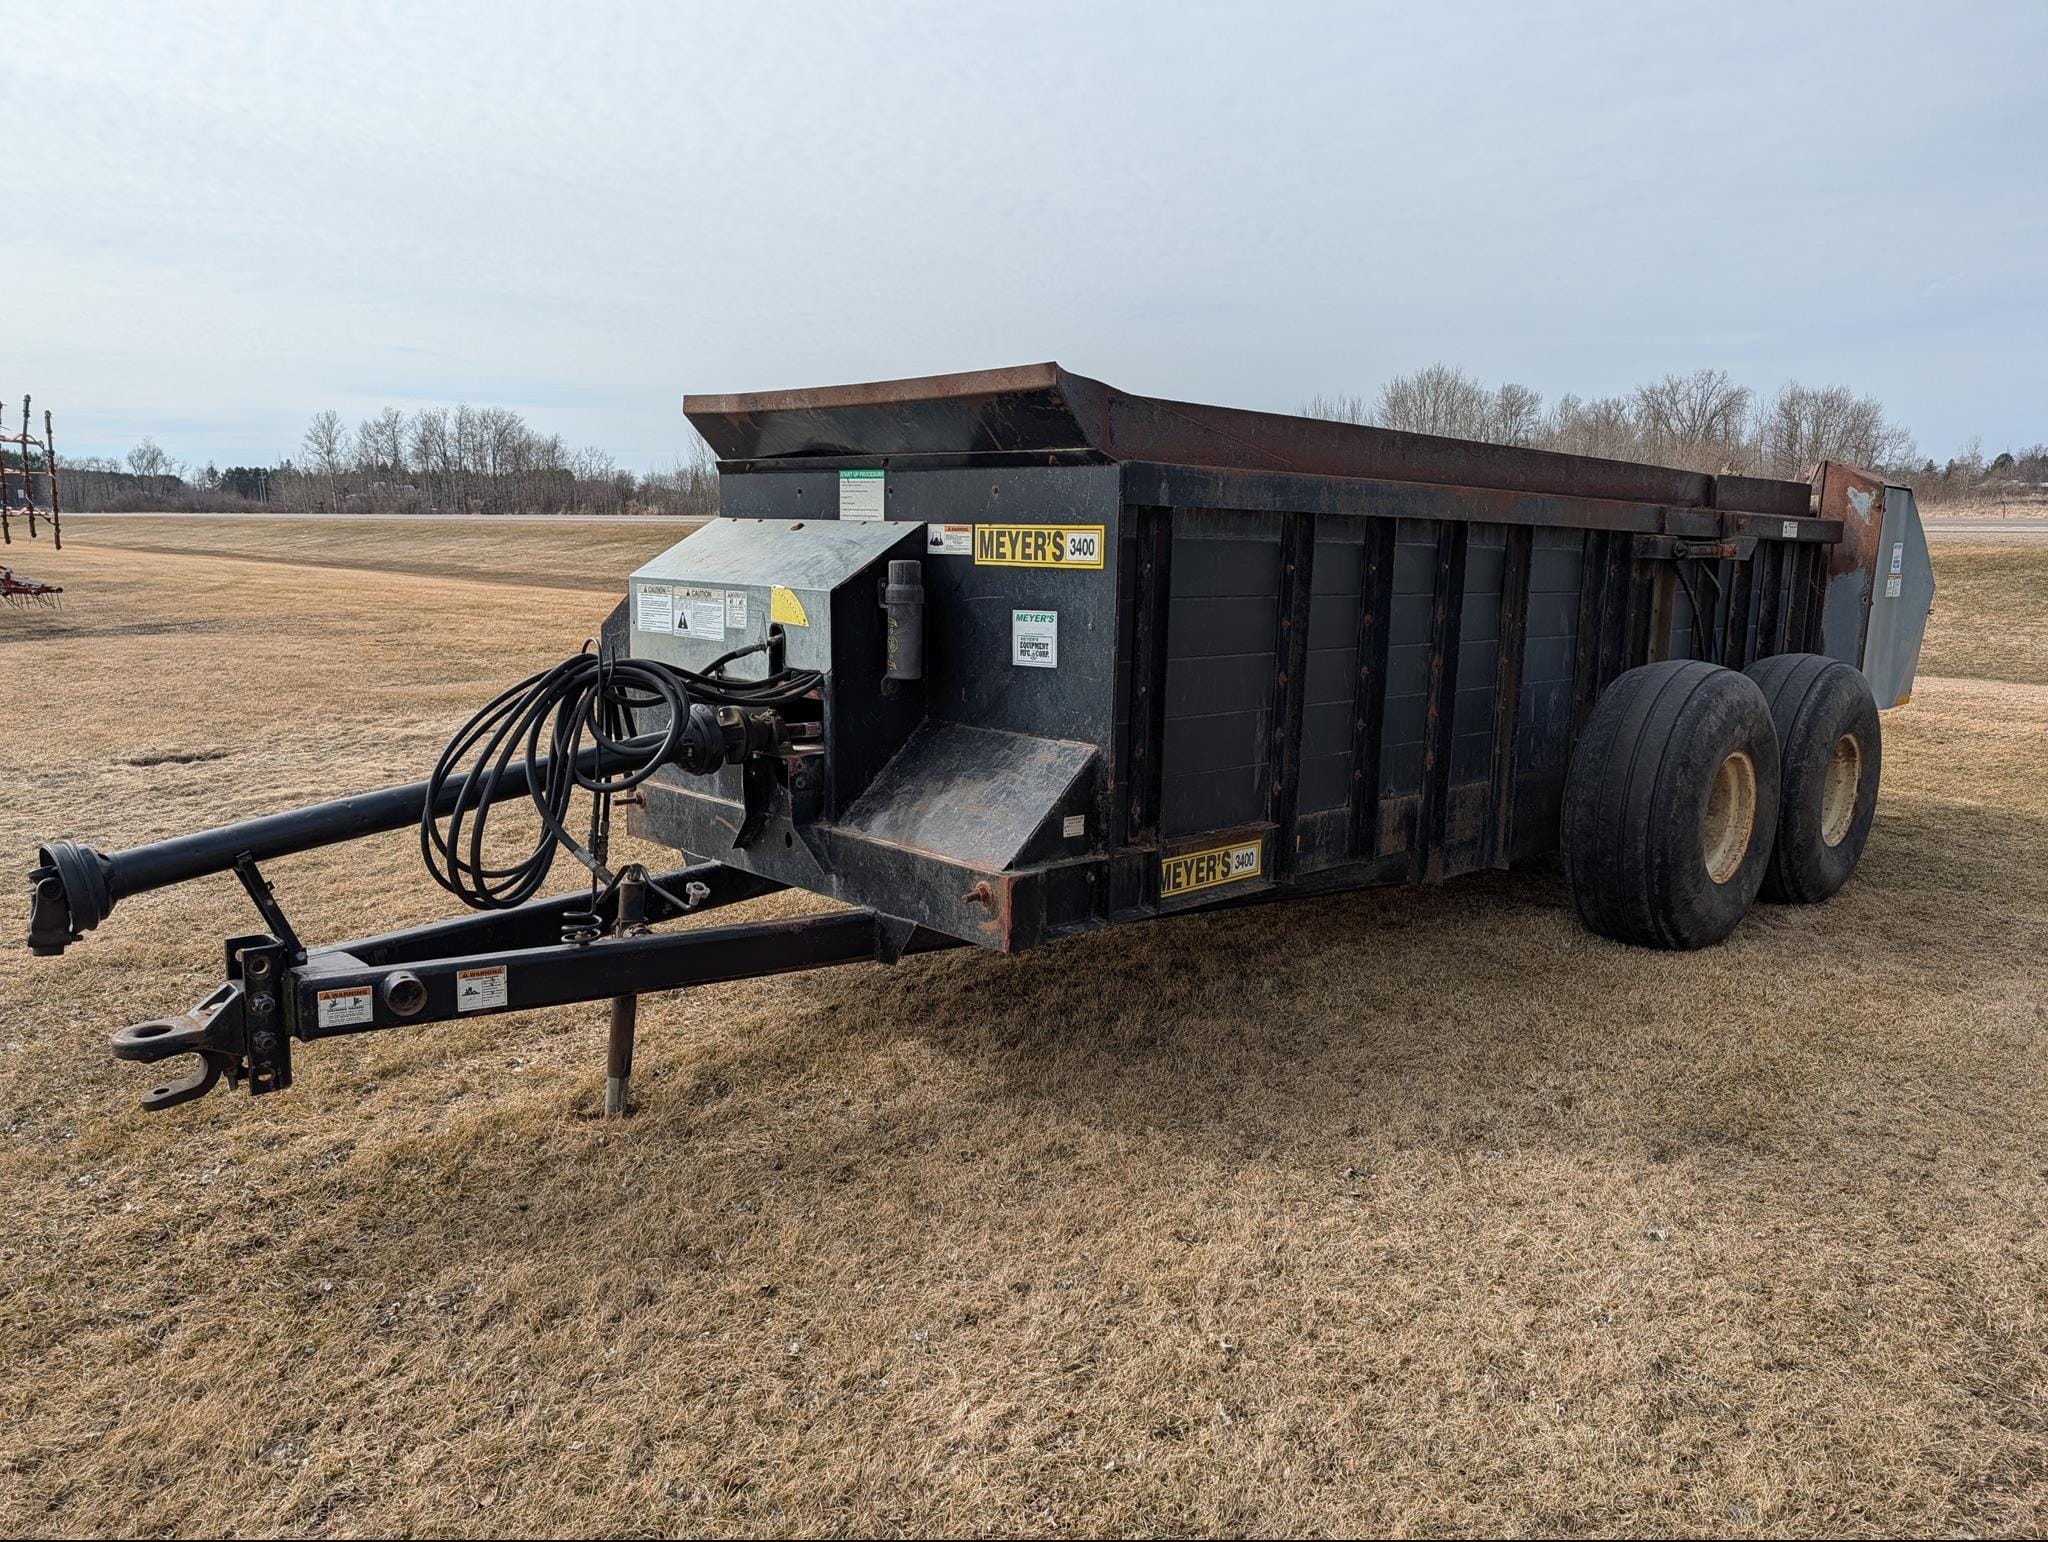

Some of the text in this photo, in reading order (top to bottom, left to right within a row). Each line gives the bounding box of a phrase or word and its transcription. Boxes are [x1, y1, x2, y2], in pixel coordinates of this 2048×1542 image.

[979, 530, 1065, 562] MEYER'S
[1070, 538, 1095, 556] 3400
[1016, 613, 1055, 623] MEYER'S
[1020, 641, 1049, 650] EQUIPMENT
[1161, 851, 1254, 891] MEYER'S 3400
[332, 989, 368, 999] WARNING
